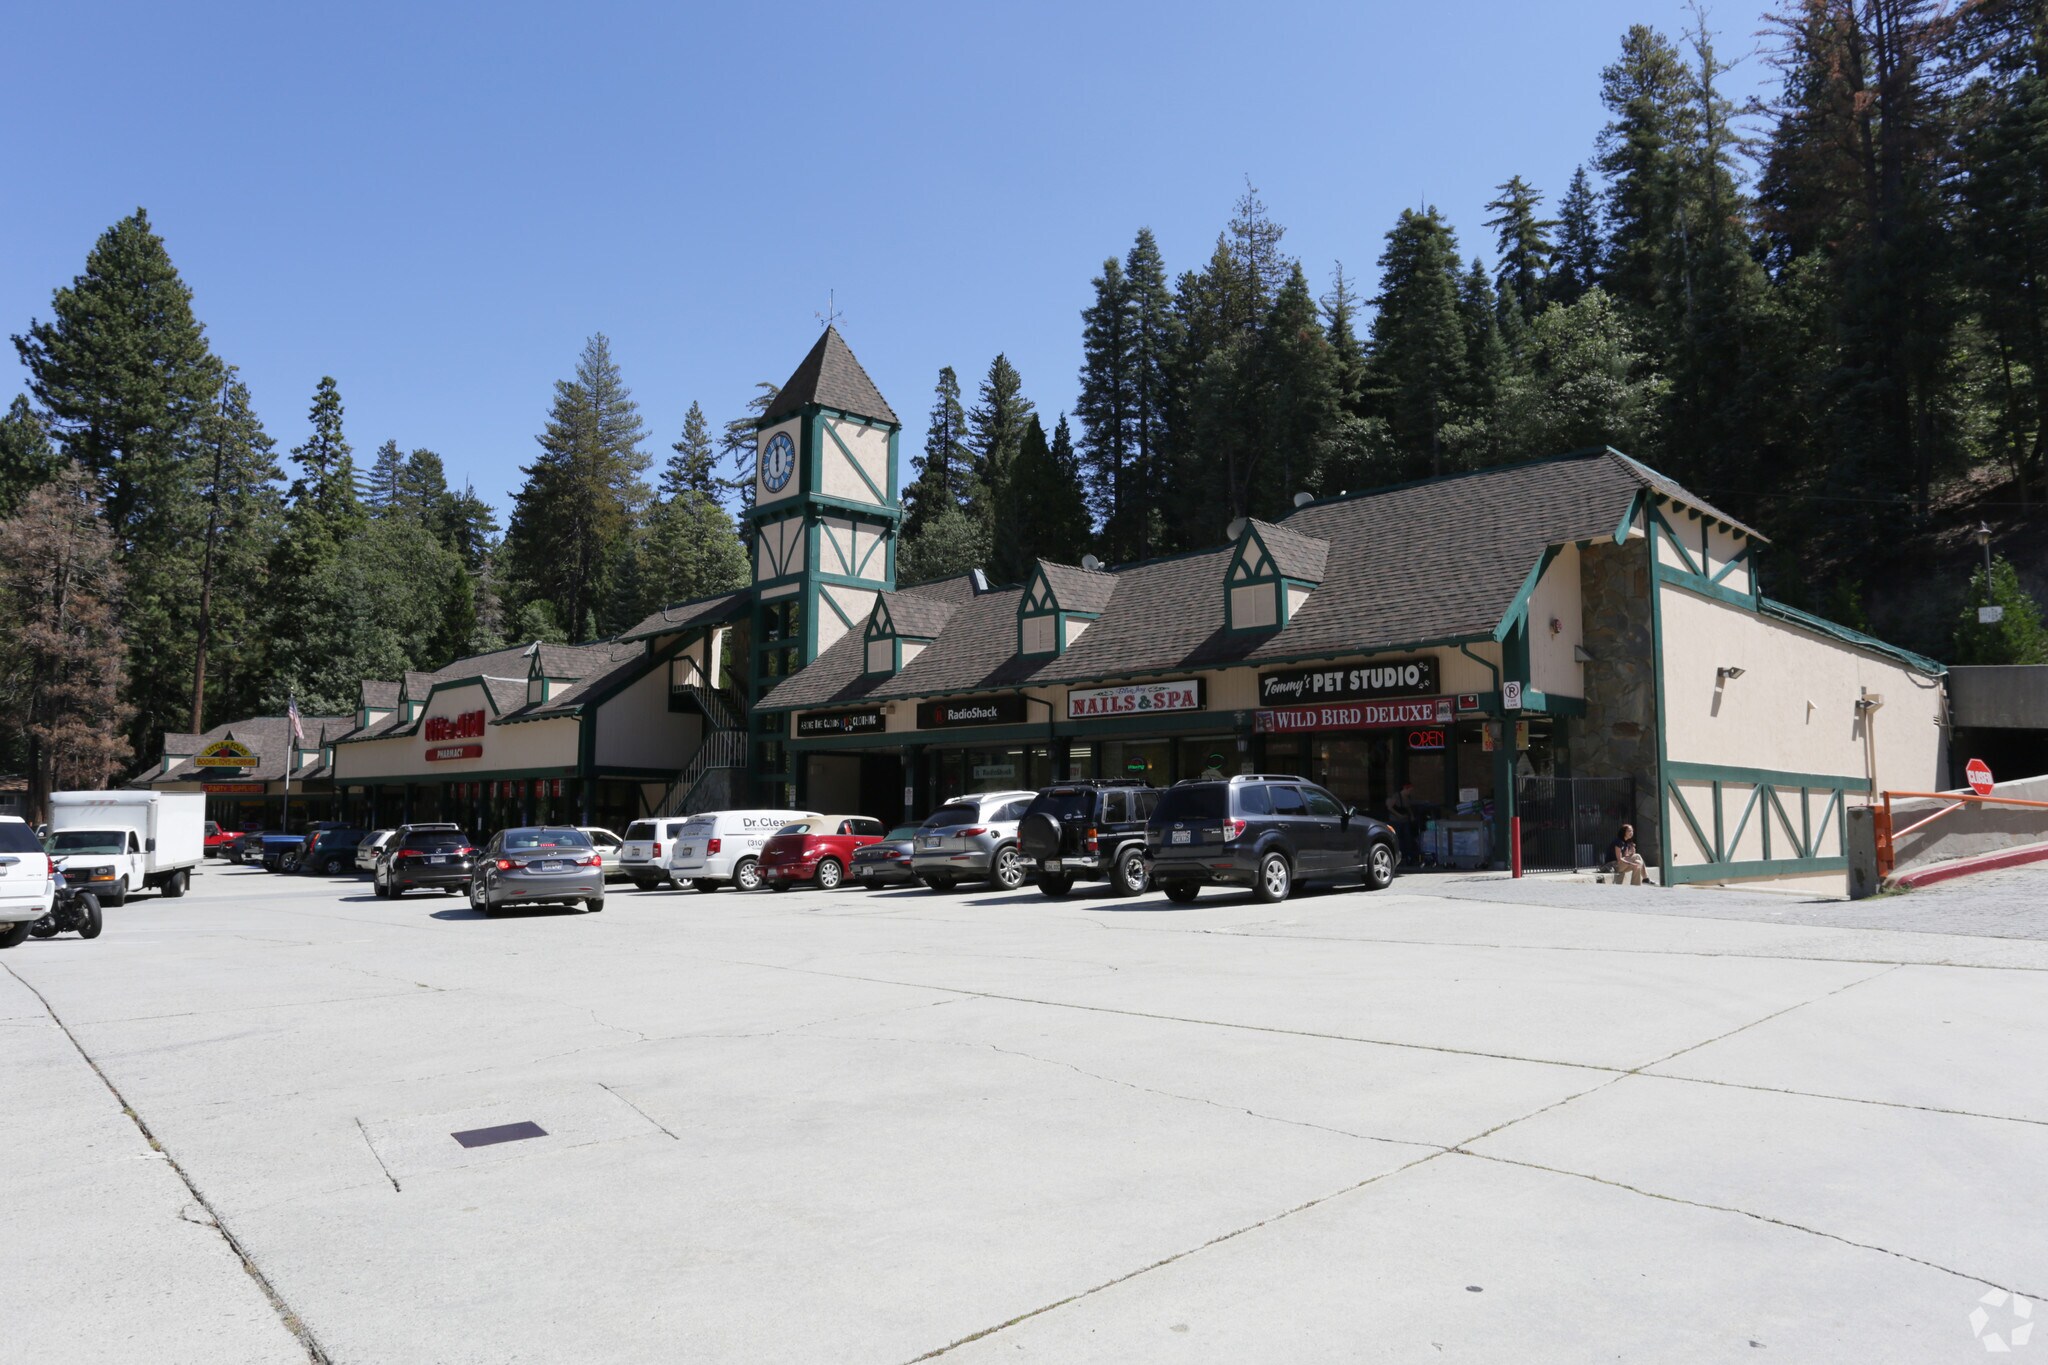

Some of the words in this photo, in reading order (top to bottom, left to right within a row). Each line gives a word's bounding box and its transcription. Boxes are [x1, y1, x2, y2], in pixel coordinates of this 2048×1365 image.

[1264, 674, 1311, 697] Tommy's
[1312, 671, 1344, 693] PET
[1349, 664, 1420, 690] STUDIO
[1072, 694, 1136, 715] NAILS
[1153, 689, 1196, 709] SPA
[852, 714, 877, 726] CLOTHING
[947, 705, 998, 720] RadioShack
[1276, 710, 1317, 728] WILD
[1321, 708, 1361, 726] BIRD
[1366, 703, 1433, 724] DELUXE
[1408, 730, 1445, 748] OPEN
[437, 747, 464, 759] PHARMACY
[1967, 770, 1993, 785] CLOSED
